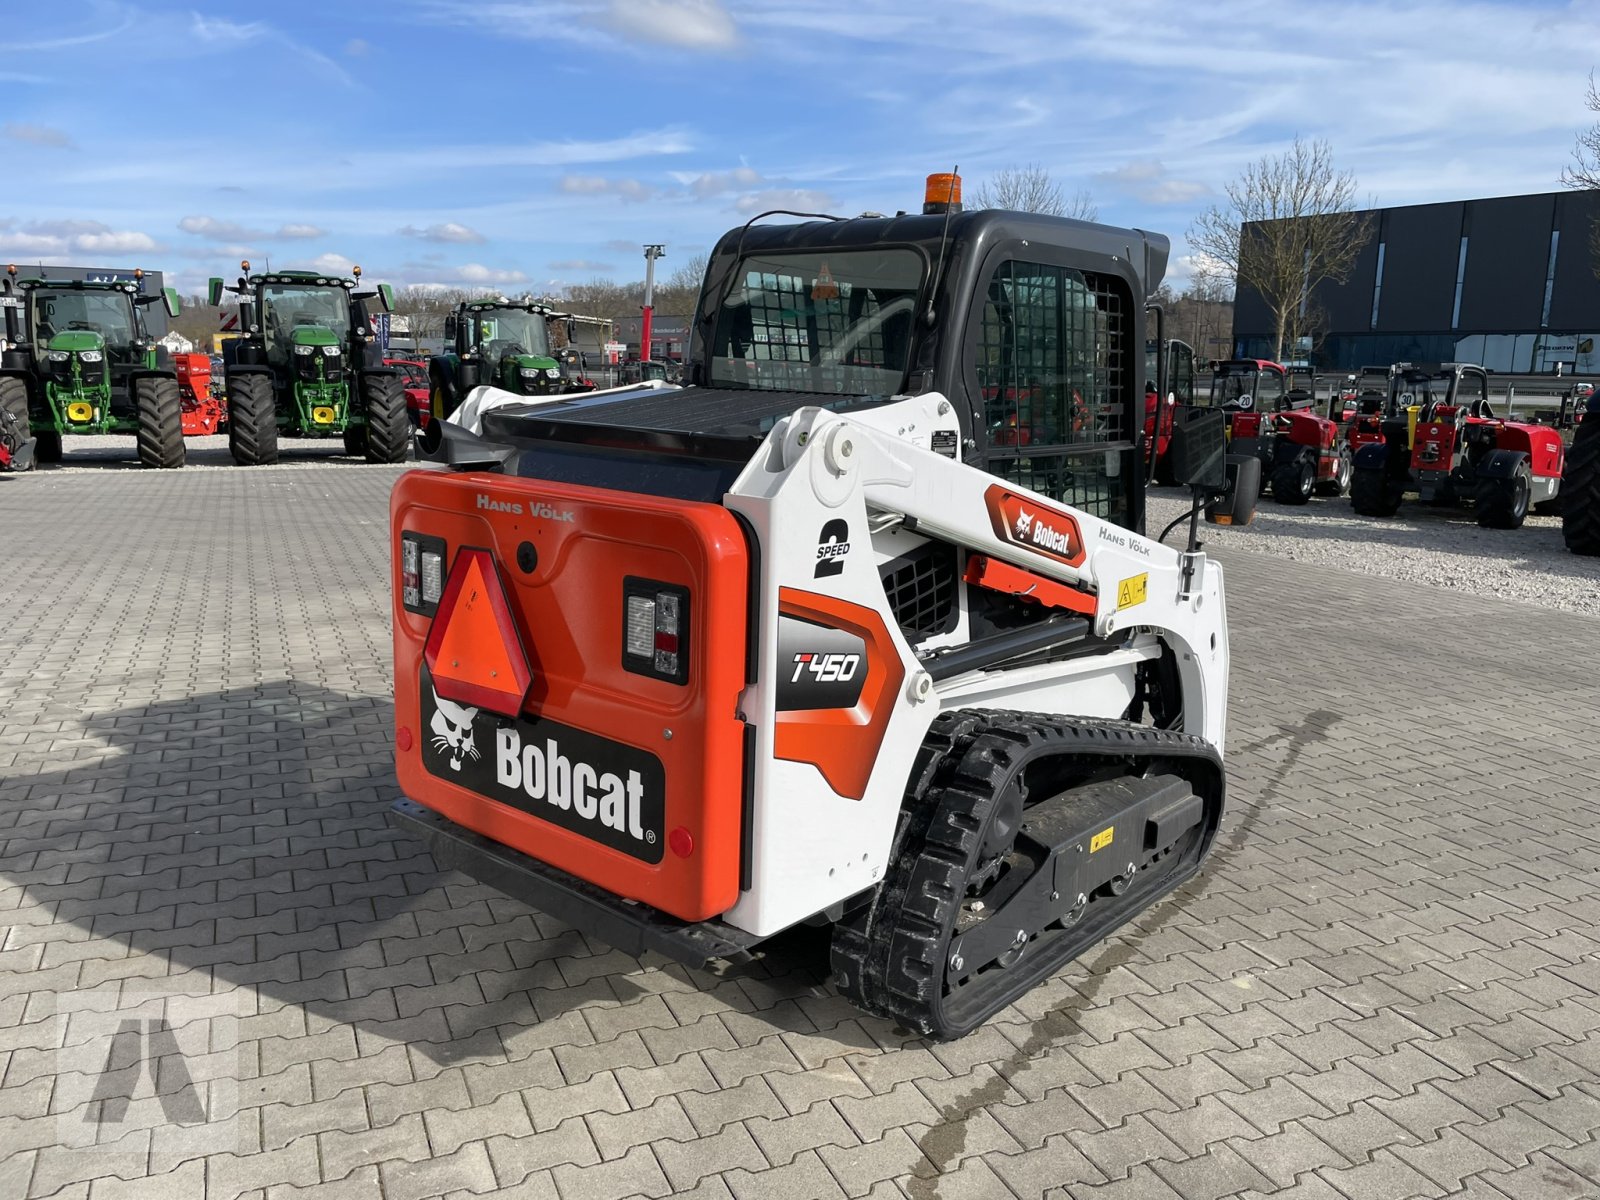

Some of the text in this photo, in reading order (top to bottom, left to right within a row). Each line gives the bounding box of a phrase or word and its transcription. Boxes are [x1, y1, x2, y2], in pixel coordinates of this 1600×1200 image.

[1241, 396, 1250, 406] 20
[1401, 395, 1412, 405] 30
[477, 494, 523, 514] HANS
[814, 518, 849, 579] 2
[1033, 520, 1069, 554] Bobcat
[816, 543, 850, 559] SPEED
[791, 654, 860, 683] T450
[496, 727, 644, 841] Bobcat
